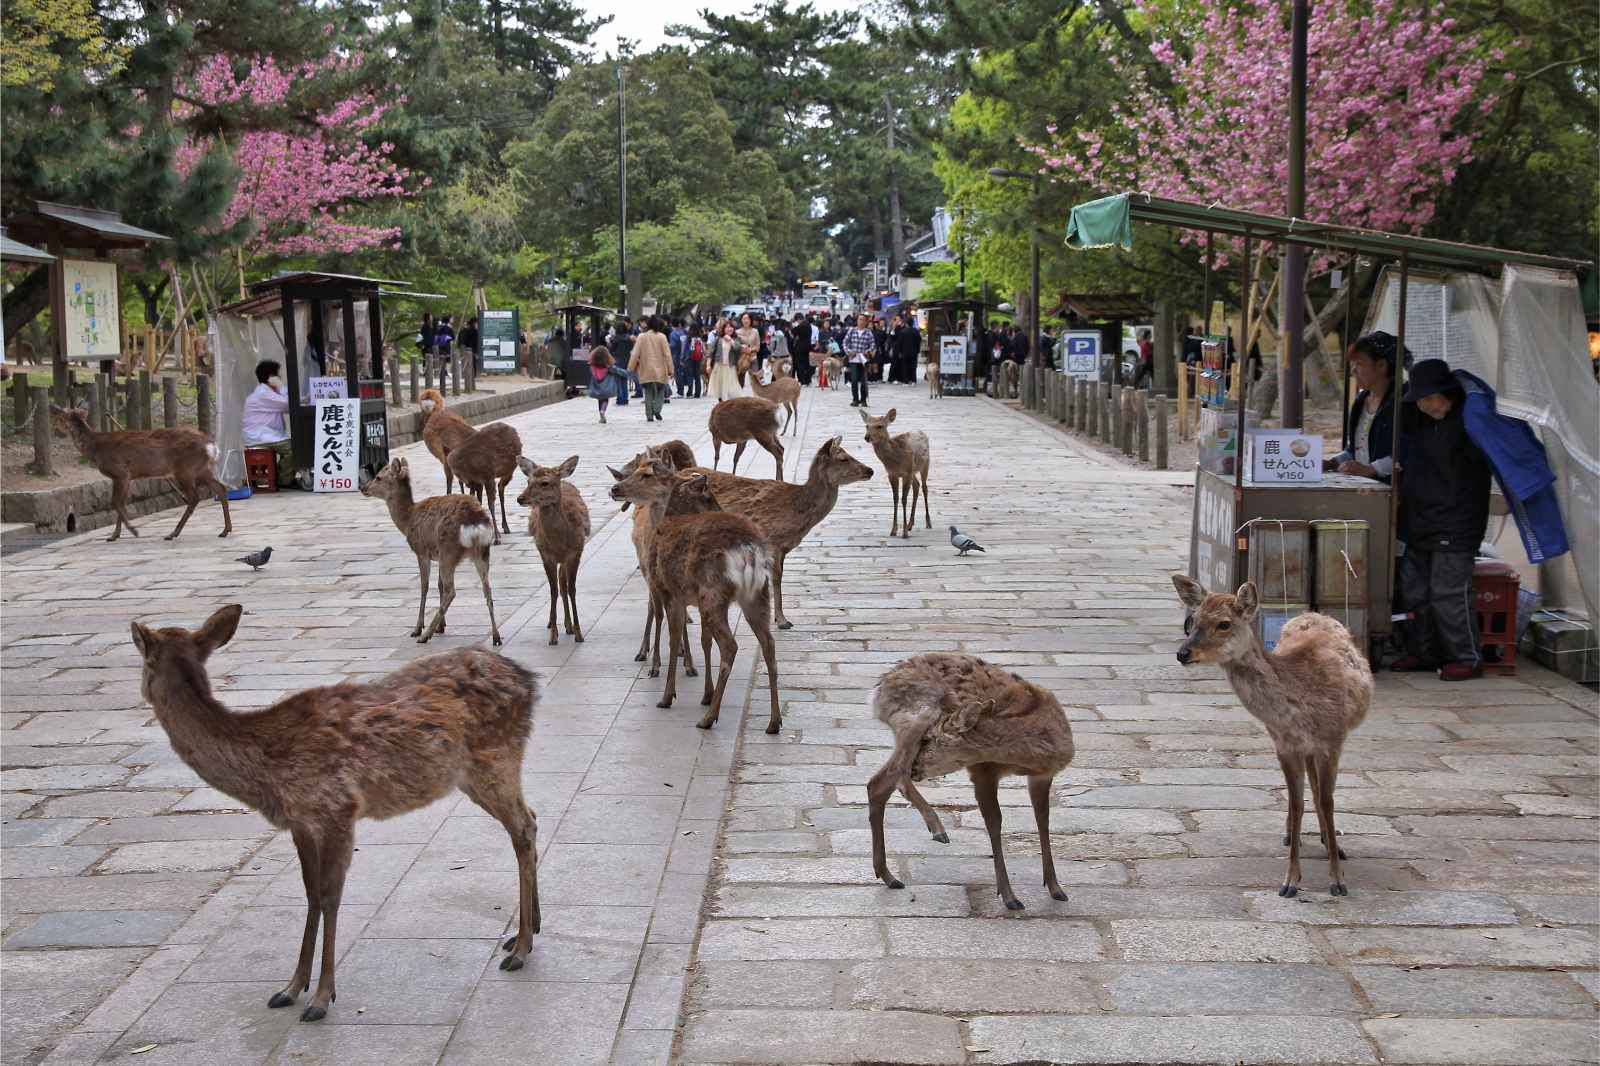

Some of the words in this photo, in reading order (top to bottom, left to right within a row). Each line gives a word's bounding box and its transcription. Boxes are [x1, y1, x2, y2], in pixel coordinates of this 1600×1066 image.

[1075, 340, 1089, 352] P
[321, 404, 345, 475] 鹿せんべい
[1264, 440, 1280, 454] 鹿
[1264, 459, 1315, 469] せんべい
[1276, 471, 1305, 480] ¥150
[320, 478, 352, 489] ¥150
